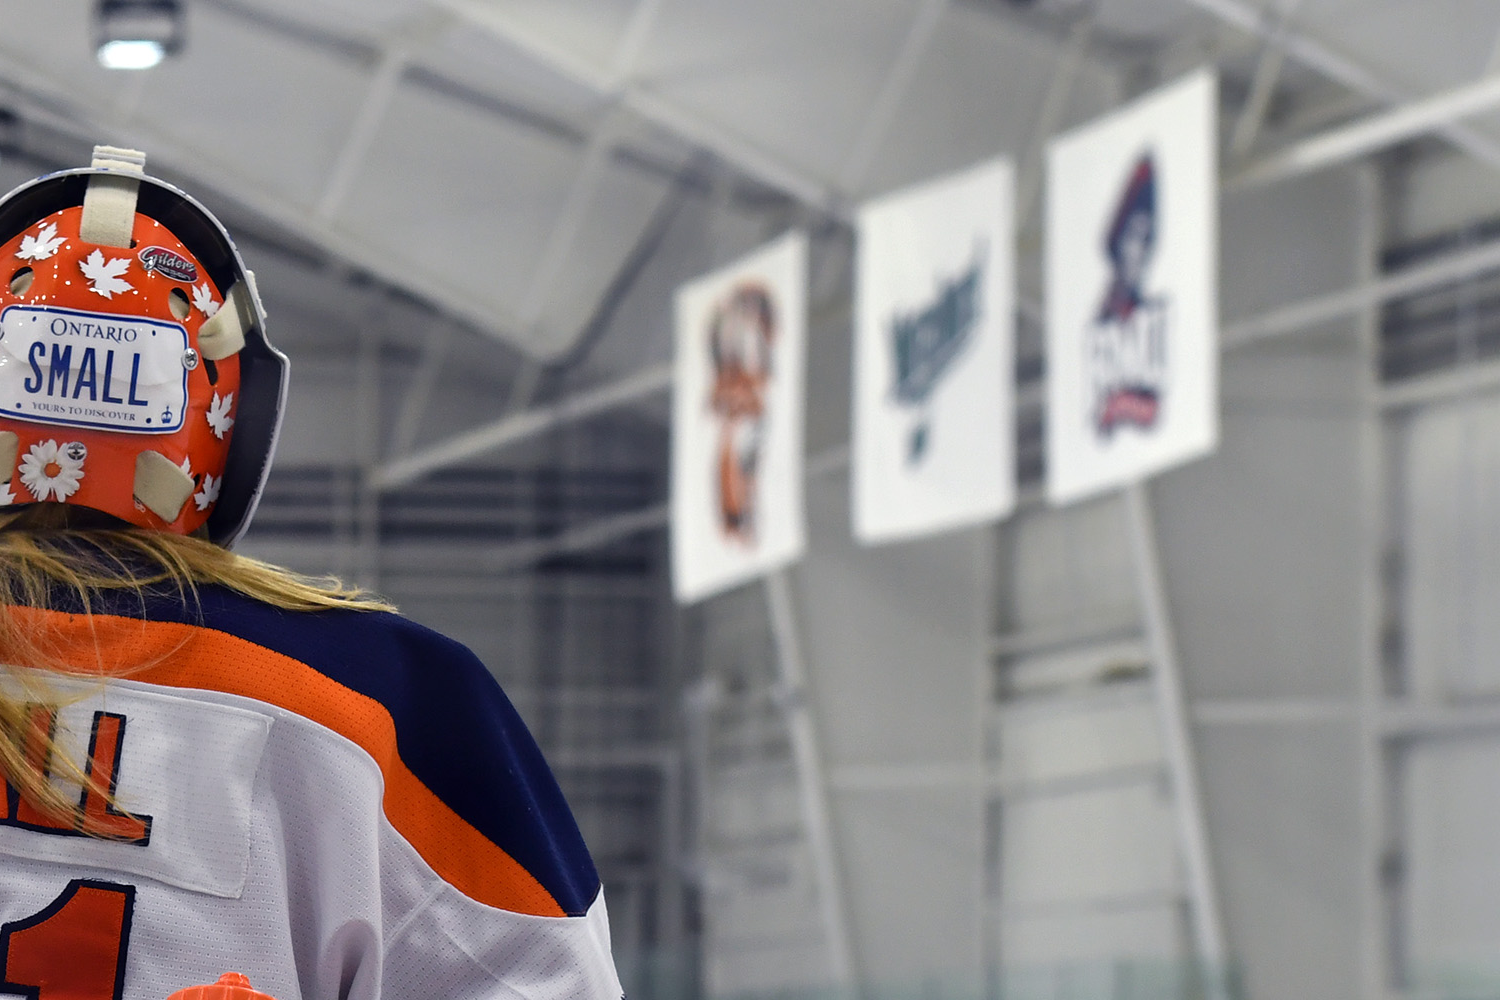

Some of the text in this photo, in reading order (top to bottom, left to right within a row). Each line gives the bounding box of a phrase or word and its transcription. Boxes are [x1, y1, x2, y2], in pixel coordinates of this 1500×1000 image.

[50, 318, 138, 343] ONTARIO
[24, 341, 149, 406] SMALL
[32, 402, 136, 421] YOURS TO DISCOVER
